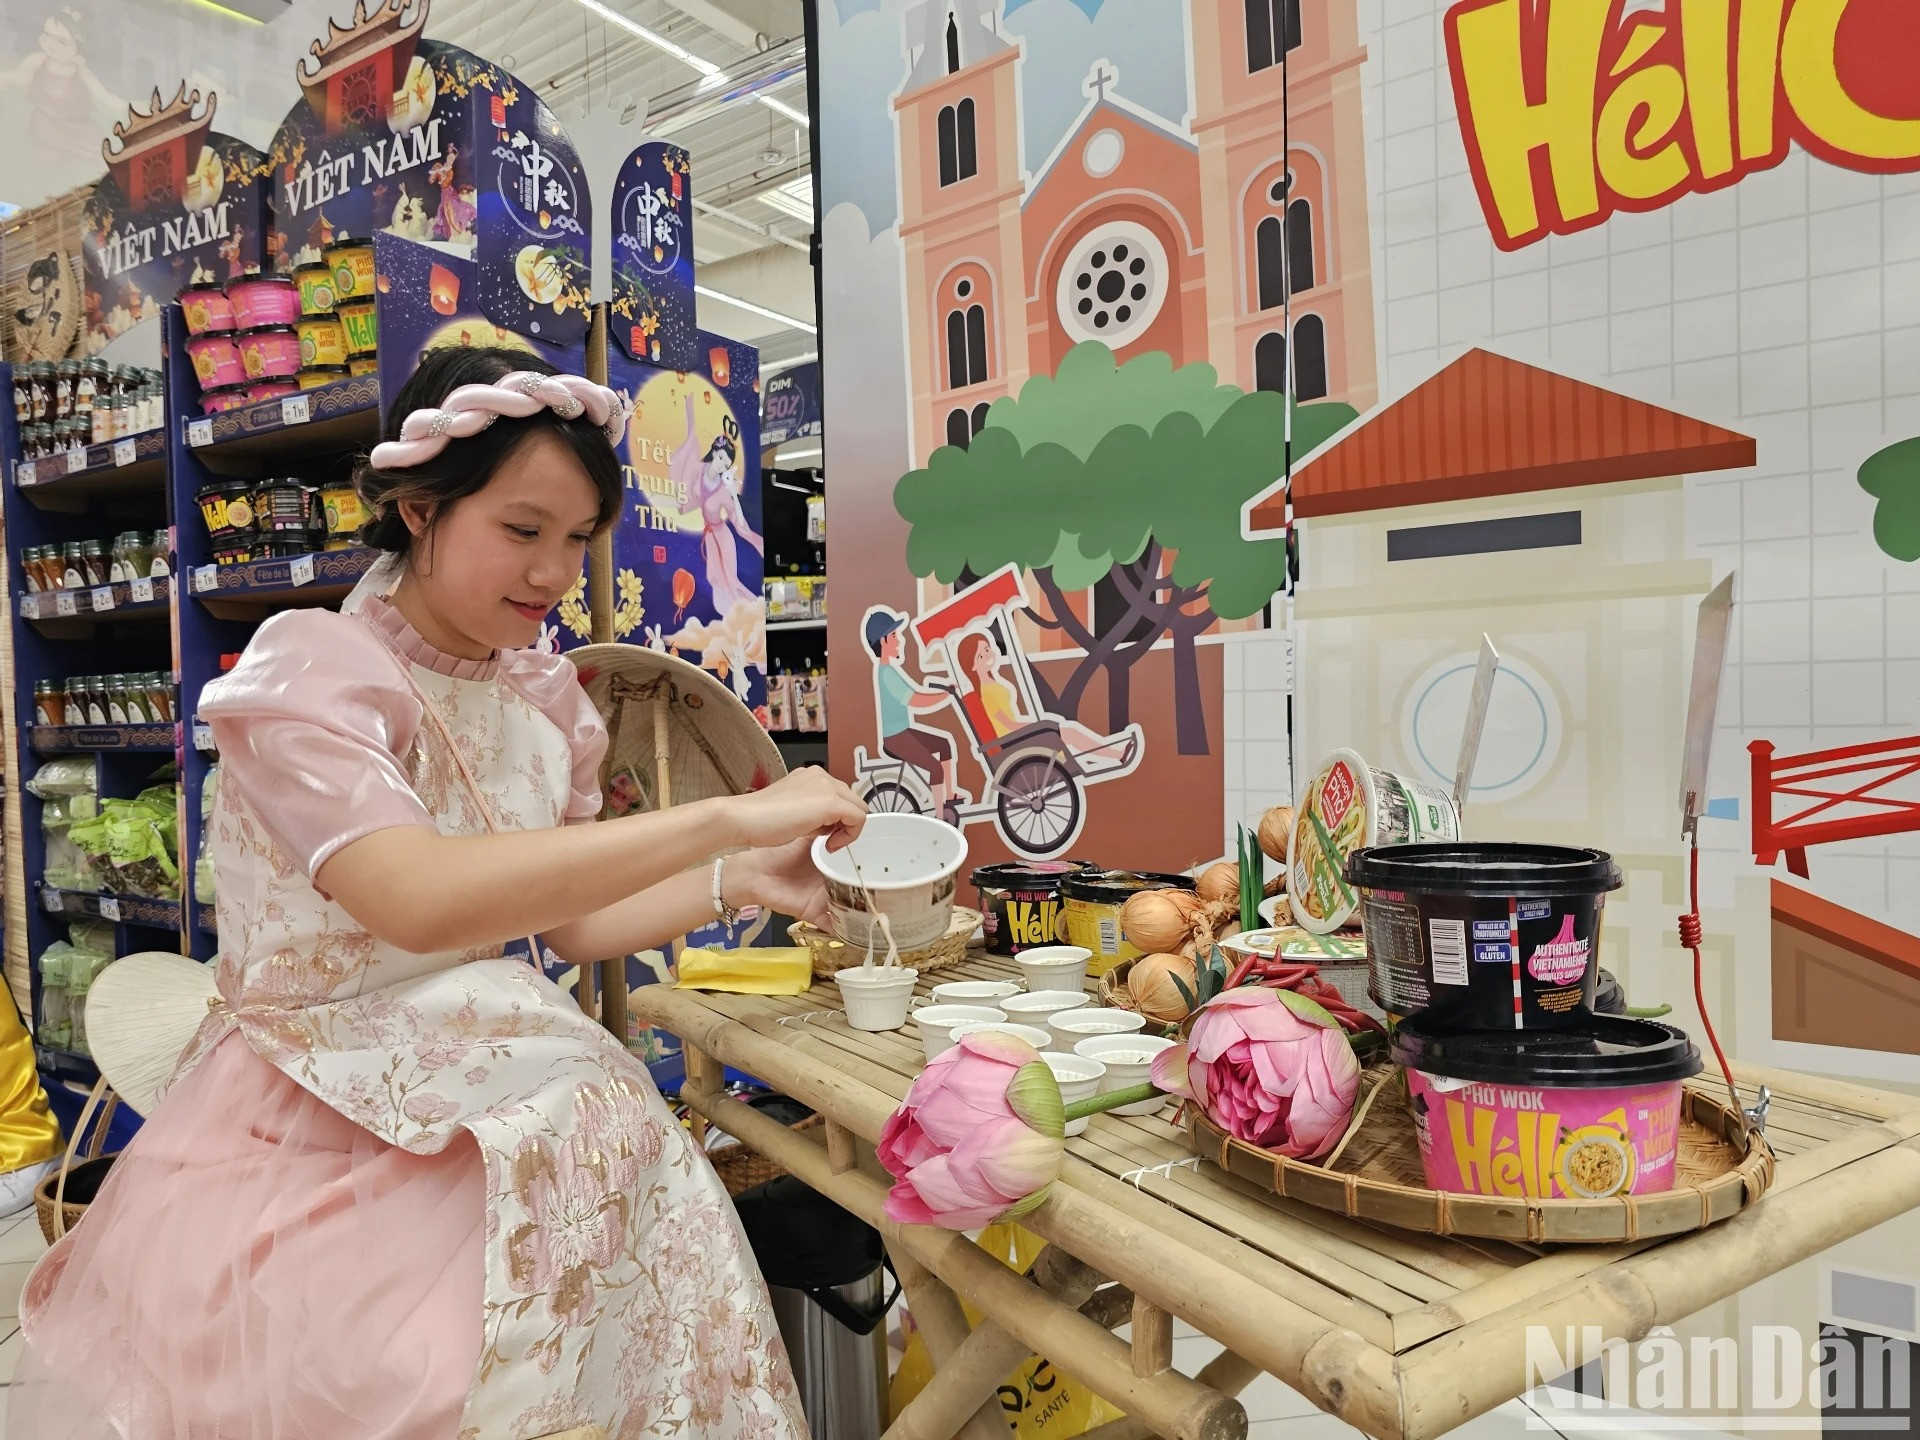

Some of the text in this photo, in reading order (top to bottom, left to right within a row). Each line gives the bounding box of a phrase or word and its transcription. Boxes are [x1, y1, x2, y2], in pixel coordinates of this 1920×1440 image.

[361, 118, 442, 186] NAM
[522, 140, 571, 214] 中秋
[161, 201, 231, 257] NAM
[637, 181, 675, 250] 中秋
[769, 377, 793, 393] DIM
[269, 409, 278, 419] de
[766, 394, 800, 421] 50%
[636, 437, 673, 466] Tết
[621, 465, 689, 505] Trung
[635, 504, 679, 533] Thu
[257, 571, 272, 580] Fête
[273, 570, 283, 579] de
[1034, 891, 1053, 901] WO
[1480, 951, 1506, 960] GLUTEN
[1534, 936, 1589, 957] AUTHENTICITÉ
[1532, 954, 1589, 971] VIETNAMIENNE
[1461, 1083, 1545, 1111] PHỞ WOK
[1638, 1109, 1649, 1121] UN
